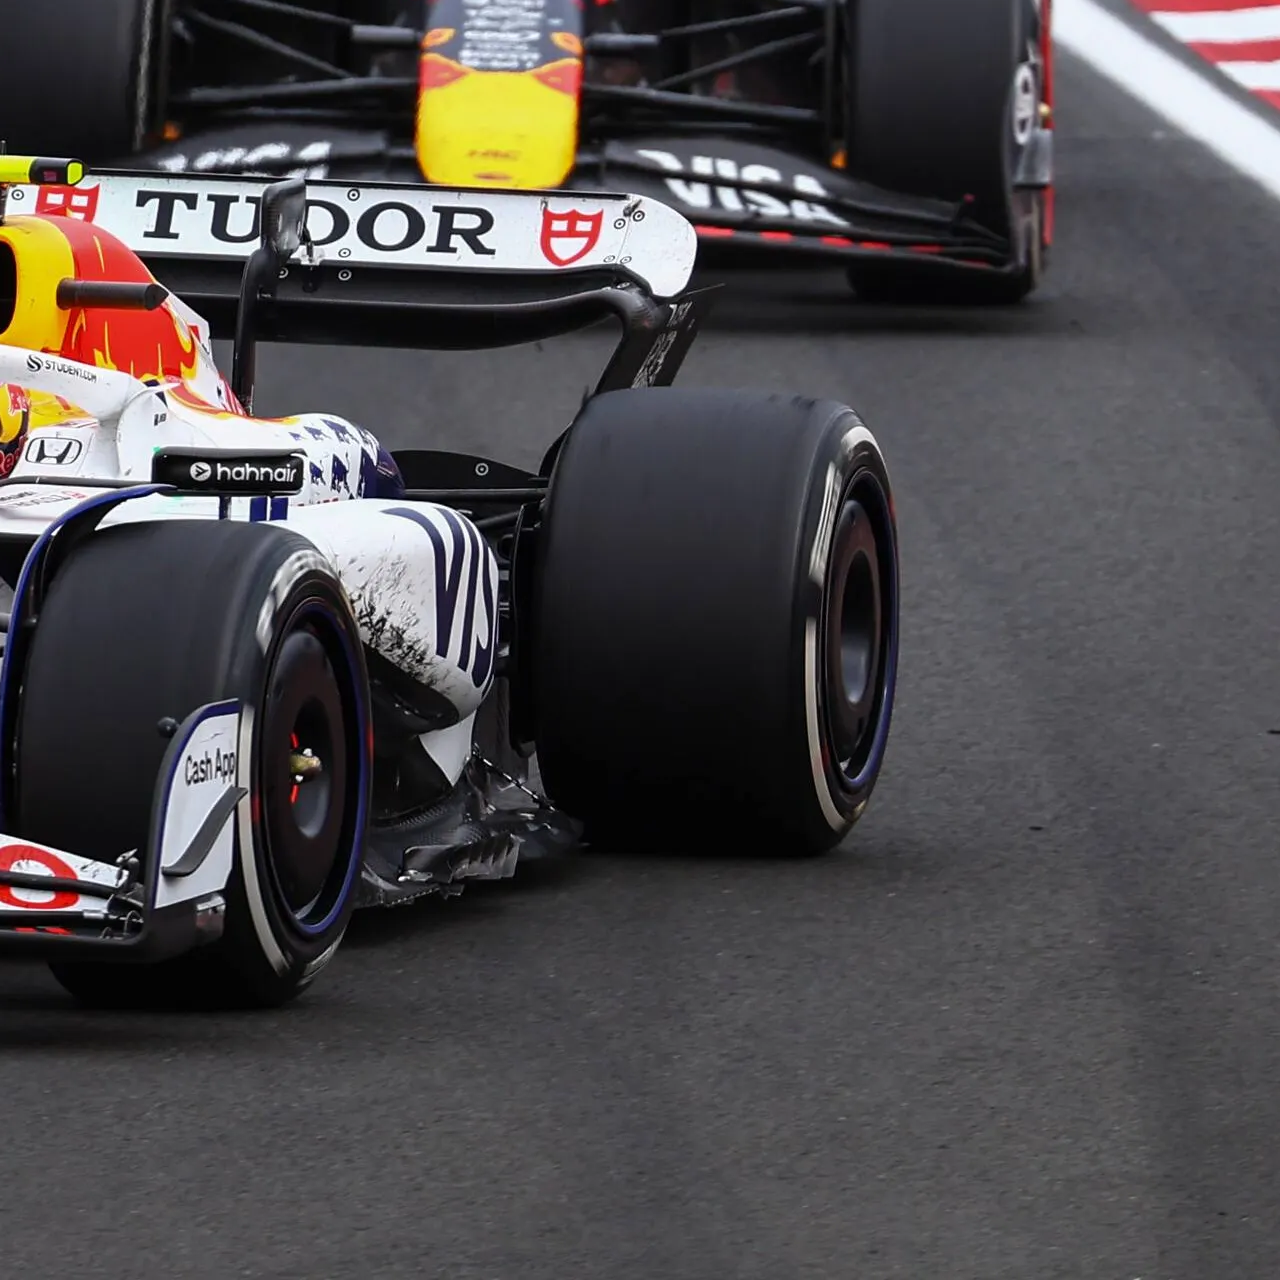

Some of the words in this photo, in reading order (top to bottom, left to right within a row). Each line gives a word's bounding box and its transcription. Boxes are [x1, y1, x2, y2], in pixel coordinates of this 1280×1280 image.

[636, 149, 851, 226] VISA
[135, 189, 496, 256] TUDOR
[216, 463, 297, 483] hahnair
[379, 507, 495, 689] VIS
[185, 751, 213, 787] Cash
[215, 747, 236, 784] App
